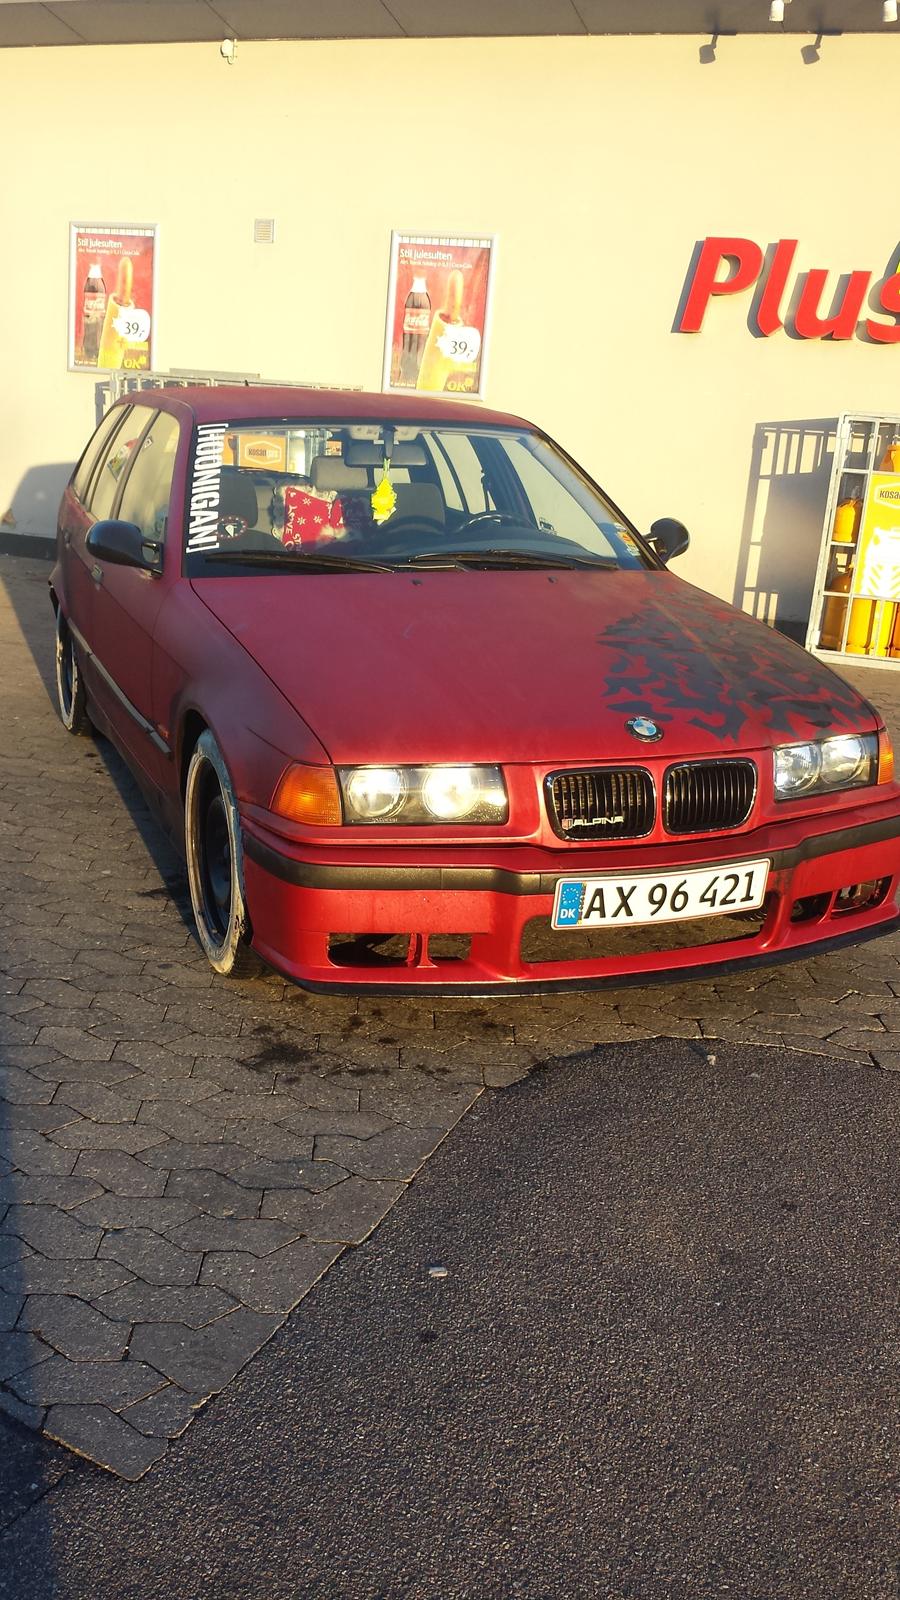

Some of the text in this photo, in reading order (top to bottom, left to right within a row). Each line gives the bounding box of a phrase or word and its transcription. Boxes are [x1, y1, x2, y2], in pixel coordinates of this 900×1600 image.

[413, 249, 453, 261] julesulten
[124, 321, 145, 338] 39,-
[449, 340, 474, 359] 39,-
[572, 816, 625, 827] ALPINA
[583, 870, 755, 919] AX 96 421
[560, 908, 576, 919] DK
